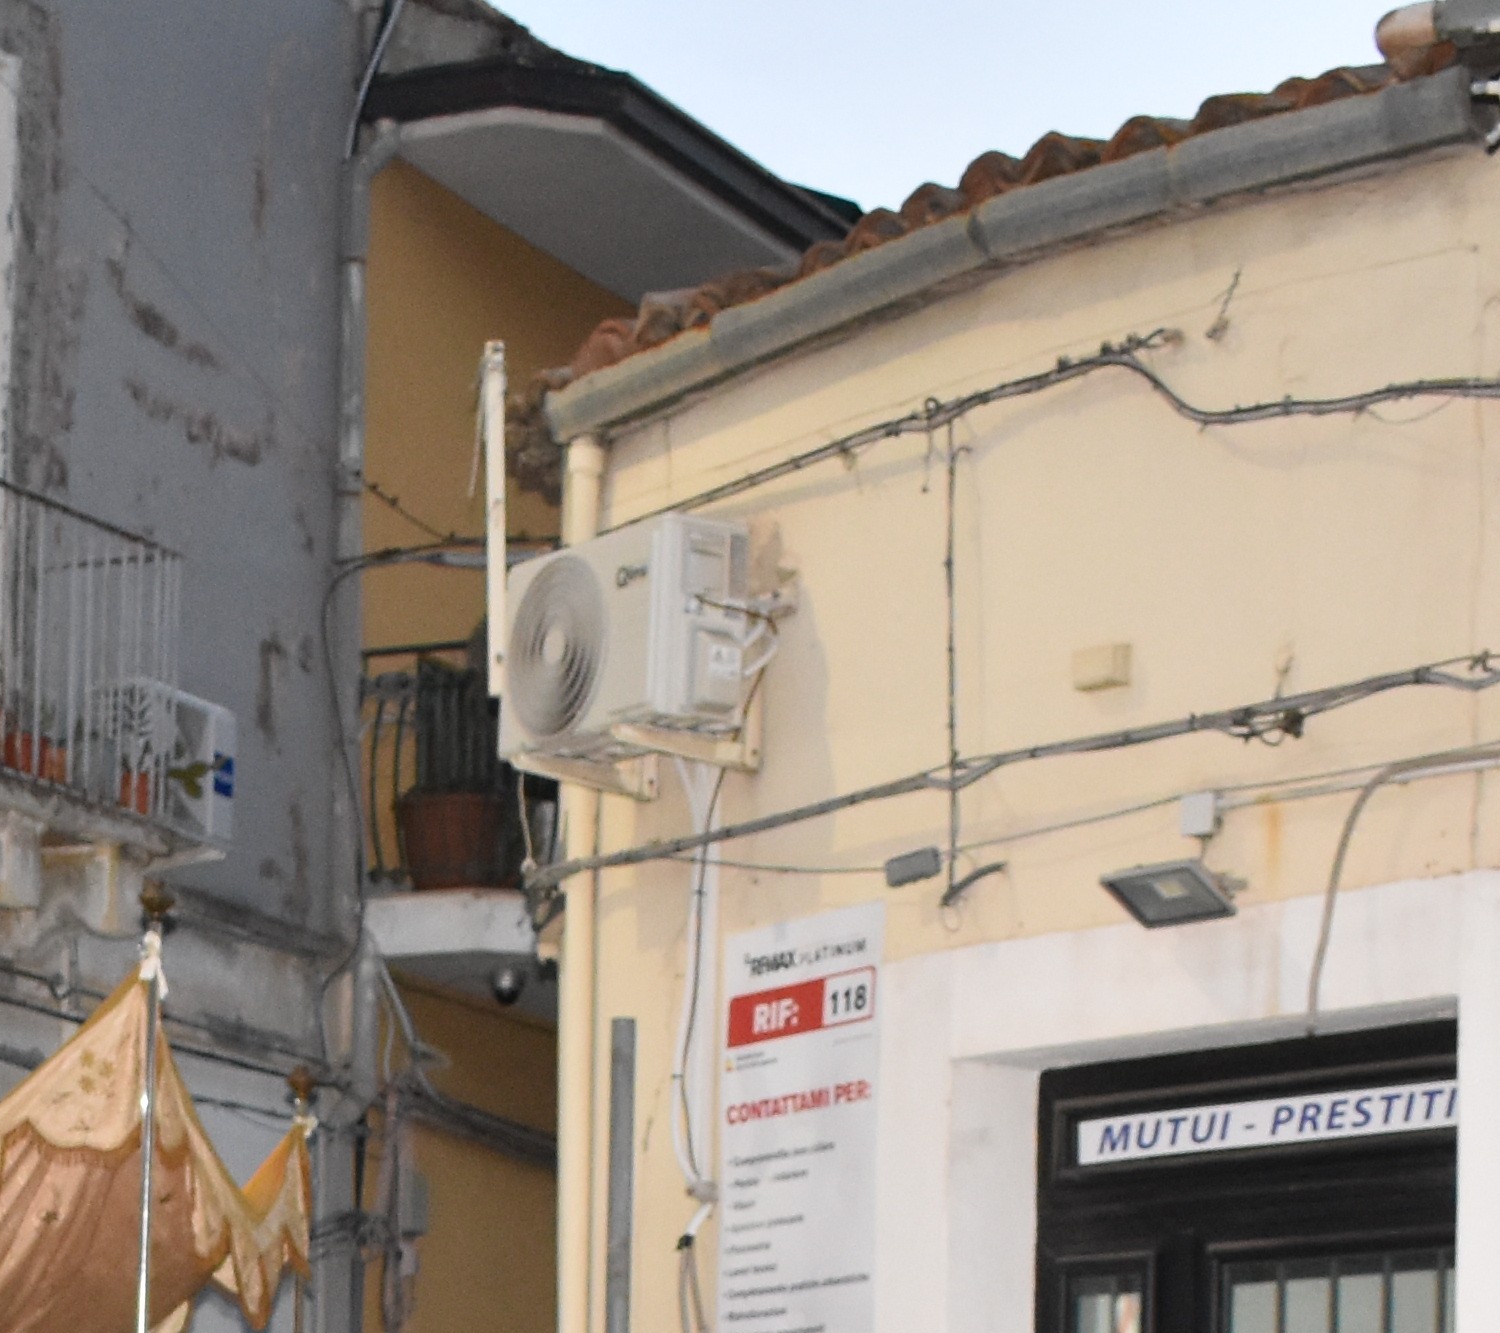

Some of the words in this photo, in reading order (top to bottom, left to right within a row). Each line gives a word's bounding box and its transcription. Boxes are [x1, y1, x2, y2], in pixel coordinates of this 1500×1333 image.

[829, 984, 868, 1016] 118
[726, 1087, 831, 1126] CONTATTAMI
[1098, 1111, 1230, 1156] MUTUI
[1271, 1086, 1457, 1136] PRESTITI
